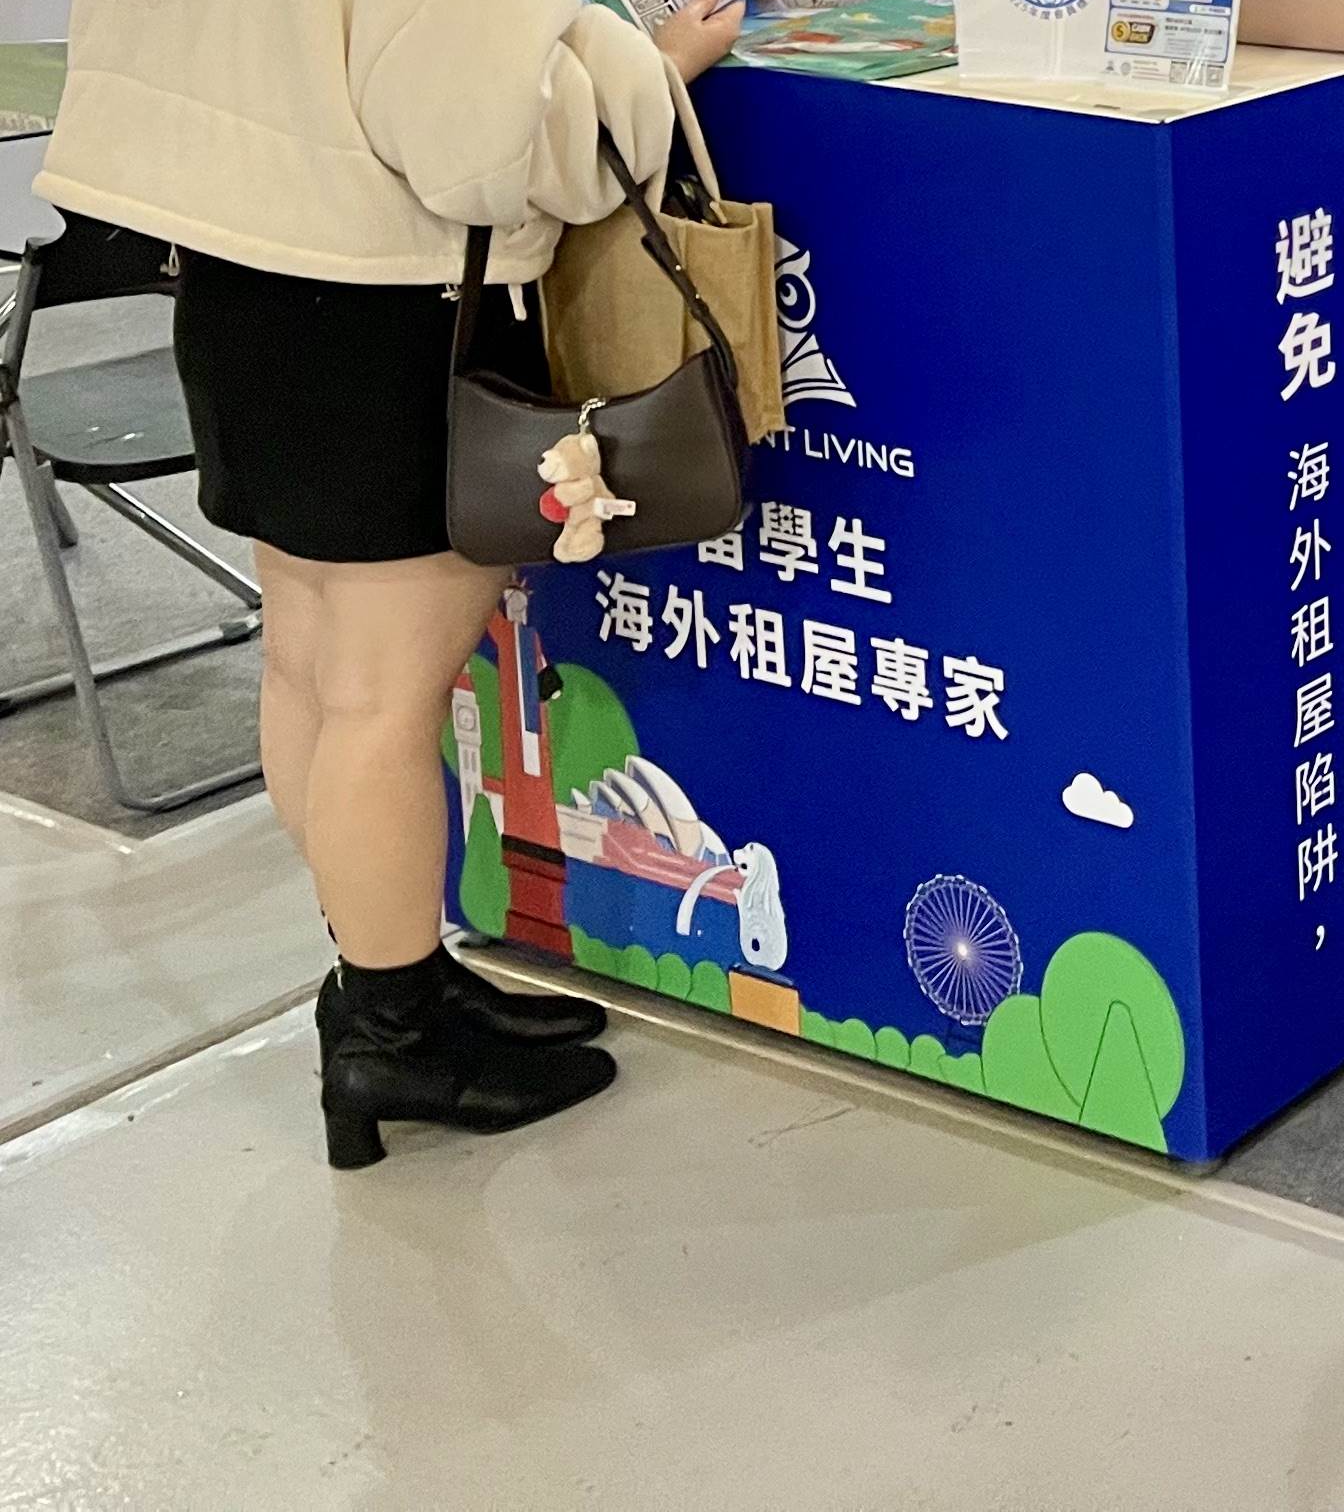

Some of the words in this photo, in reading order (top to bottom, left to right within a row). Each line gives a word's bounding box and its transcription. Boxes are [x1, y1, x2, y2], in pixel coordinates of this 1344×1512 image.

[1275, 207, 1336, 402] 避免
[804, 428, 914, 478] LIVING
[596, 570, 1010, 741] 海外租屋專家
